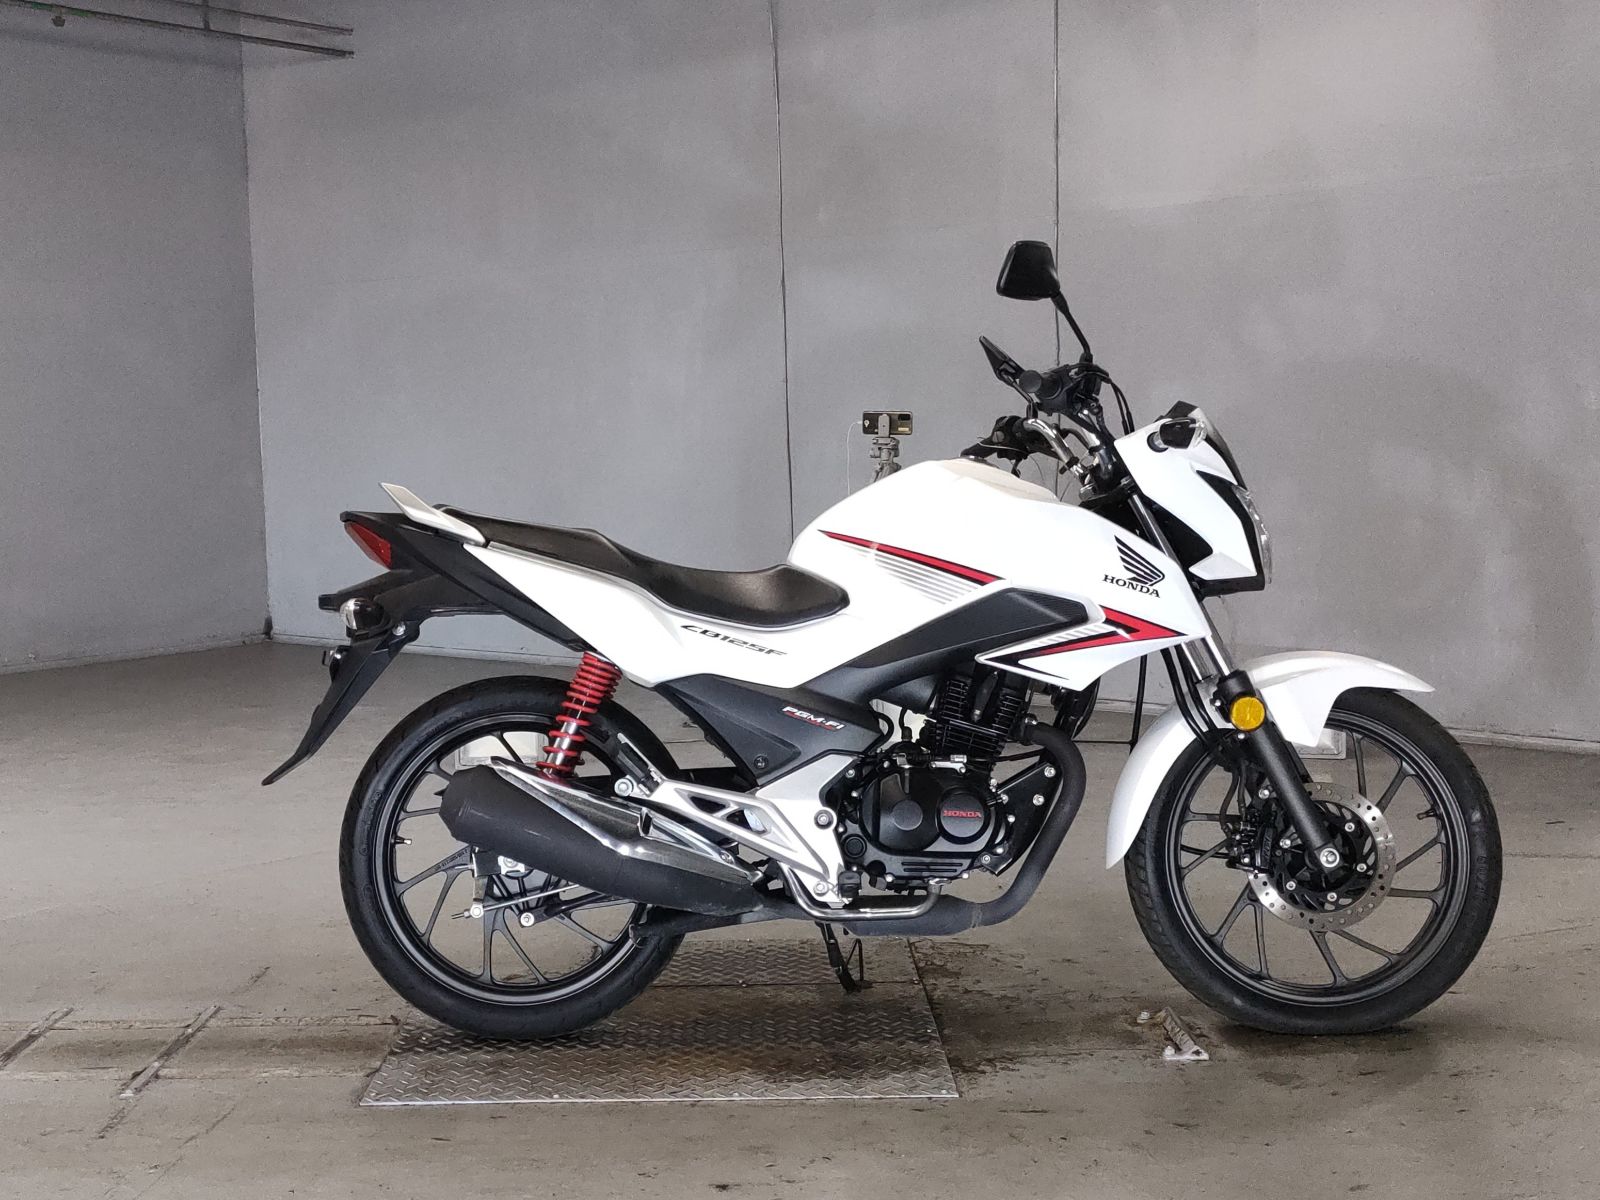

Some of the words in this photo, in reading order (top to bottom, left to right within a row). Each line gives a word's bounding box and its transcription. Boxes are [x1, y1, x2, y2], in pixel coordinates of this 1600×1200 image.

[1102, 574, 1161, 598] HONDA
[680, 624, 788, 656] CB125F
[781, 705, 846, 730] PGM-FI
[943, 809, 982, 819] HONDA
